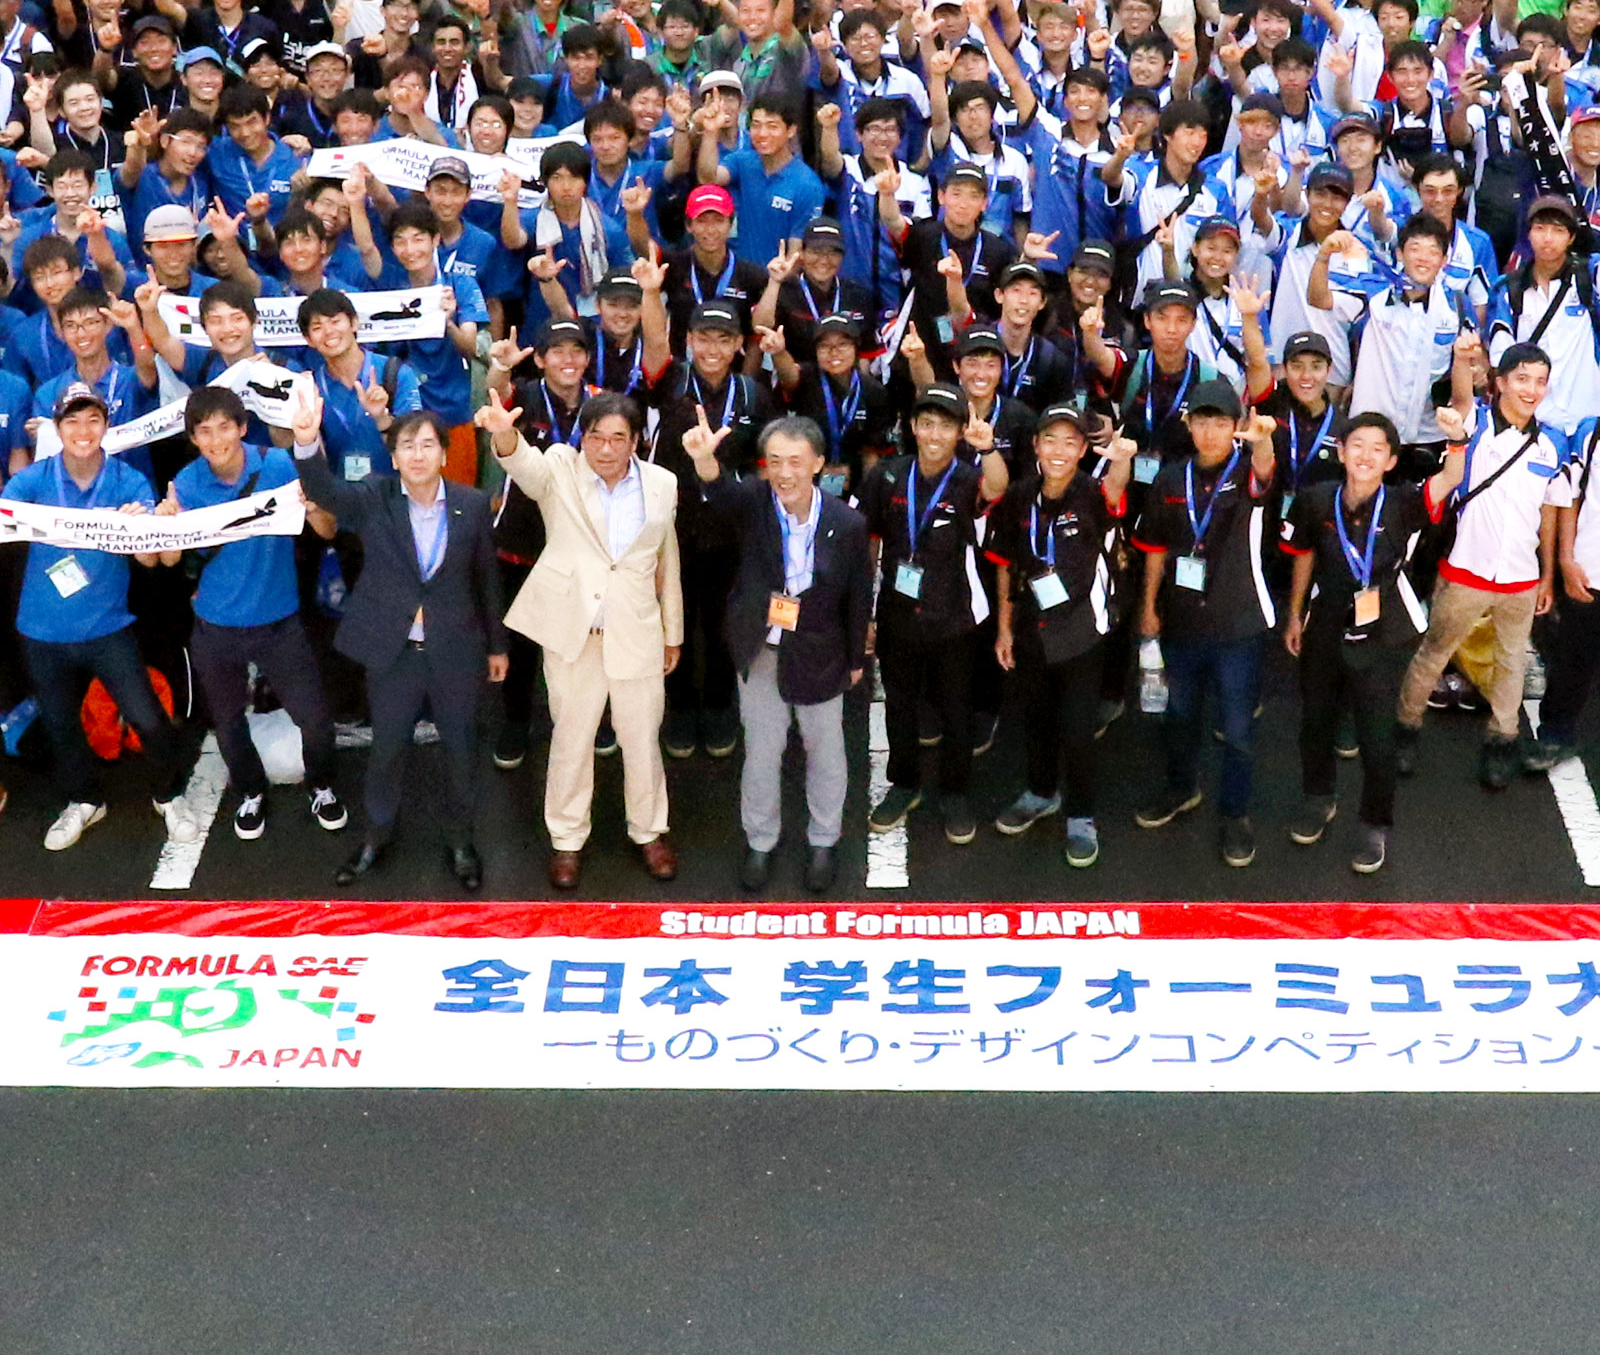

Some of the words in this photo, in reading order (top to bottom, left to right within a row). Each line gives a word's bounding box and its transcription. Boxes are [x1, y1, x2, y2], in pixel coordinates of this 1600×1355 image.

[54, 518, 128, 532] FORMULA
[74, 529, 203, 542] ENTERTAINMENT
[660, 911, 828, 936] Student
[836, 911, 1002, 936] Formula
[1017, 911, 1141, 936] JAPAN
[81, 954, 277, 977] FORMULA
[287, 956, 369, 977] SAE
[433, 958, 732, 1015] 全日本
[219, 1047, 362, 1069] JAPAN
